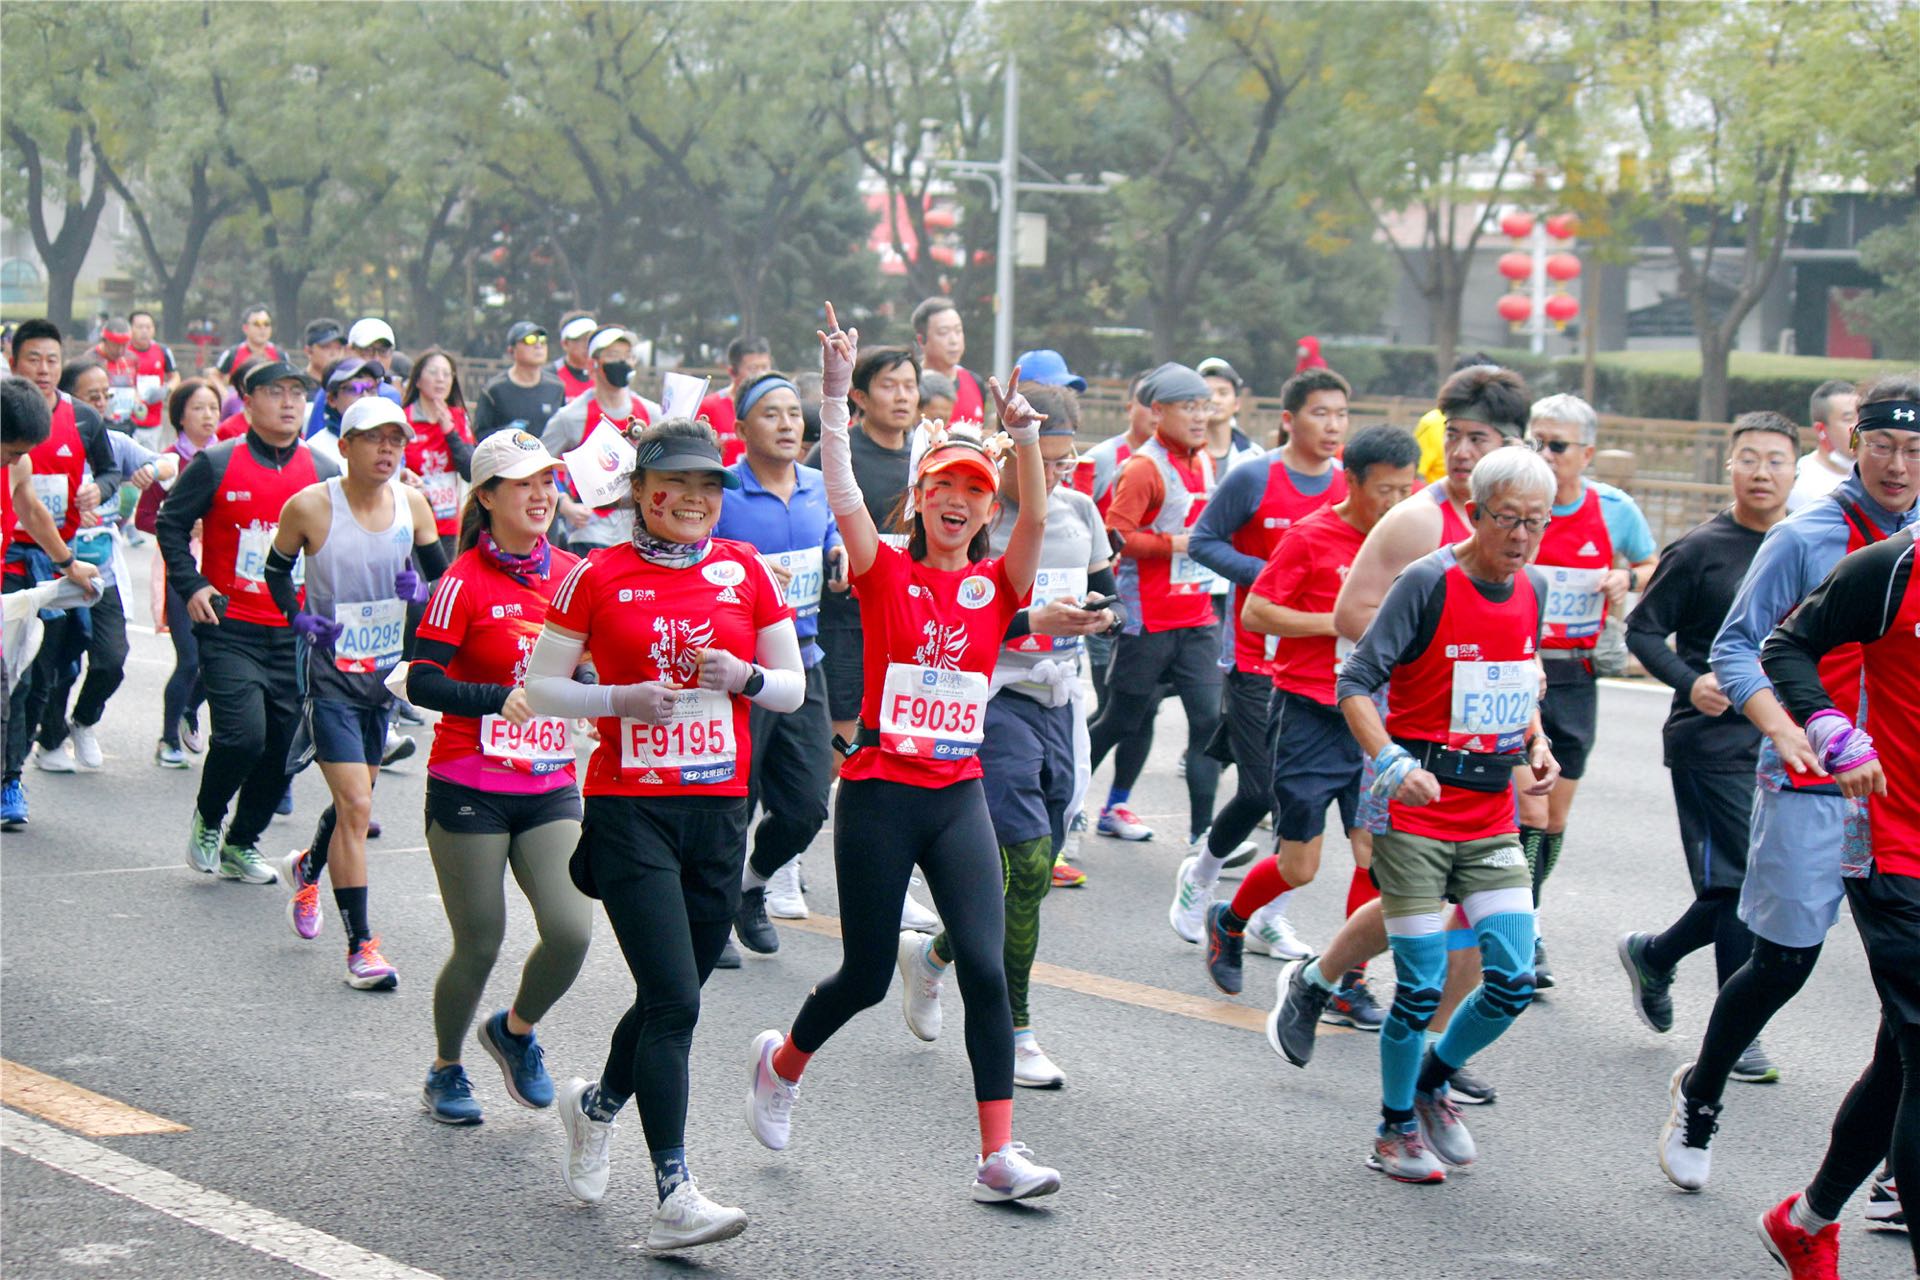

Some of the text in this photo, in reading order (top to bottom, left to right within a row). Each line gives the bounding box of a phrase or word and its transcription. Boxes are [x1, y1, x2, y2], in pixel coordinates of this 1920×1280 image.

[716, 595, 741, 604] adidas
[342, 622, 400, 652] A0295
[892, 694, 977, 733] F9035
[1463, 692, 1530, 725] F3022
[491, 720, 566, 751] F9463
[631, 720, 725, 757] F9195
[701, 767, 732, 779] 北京现代
